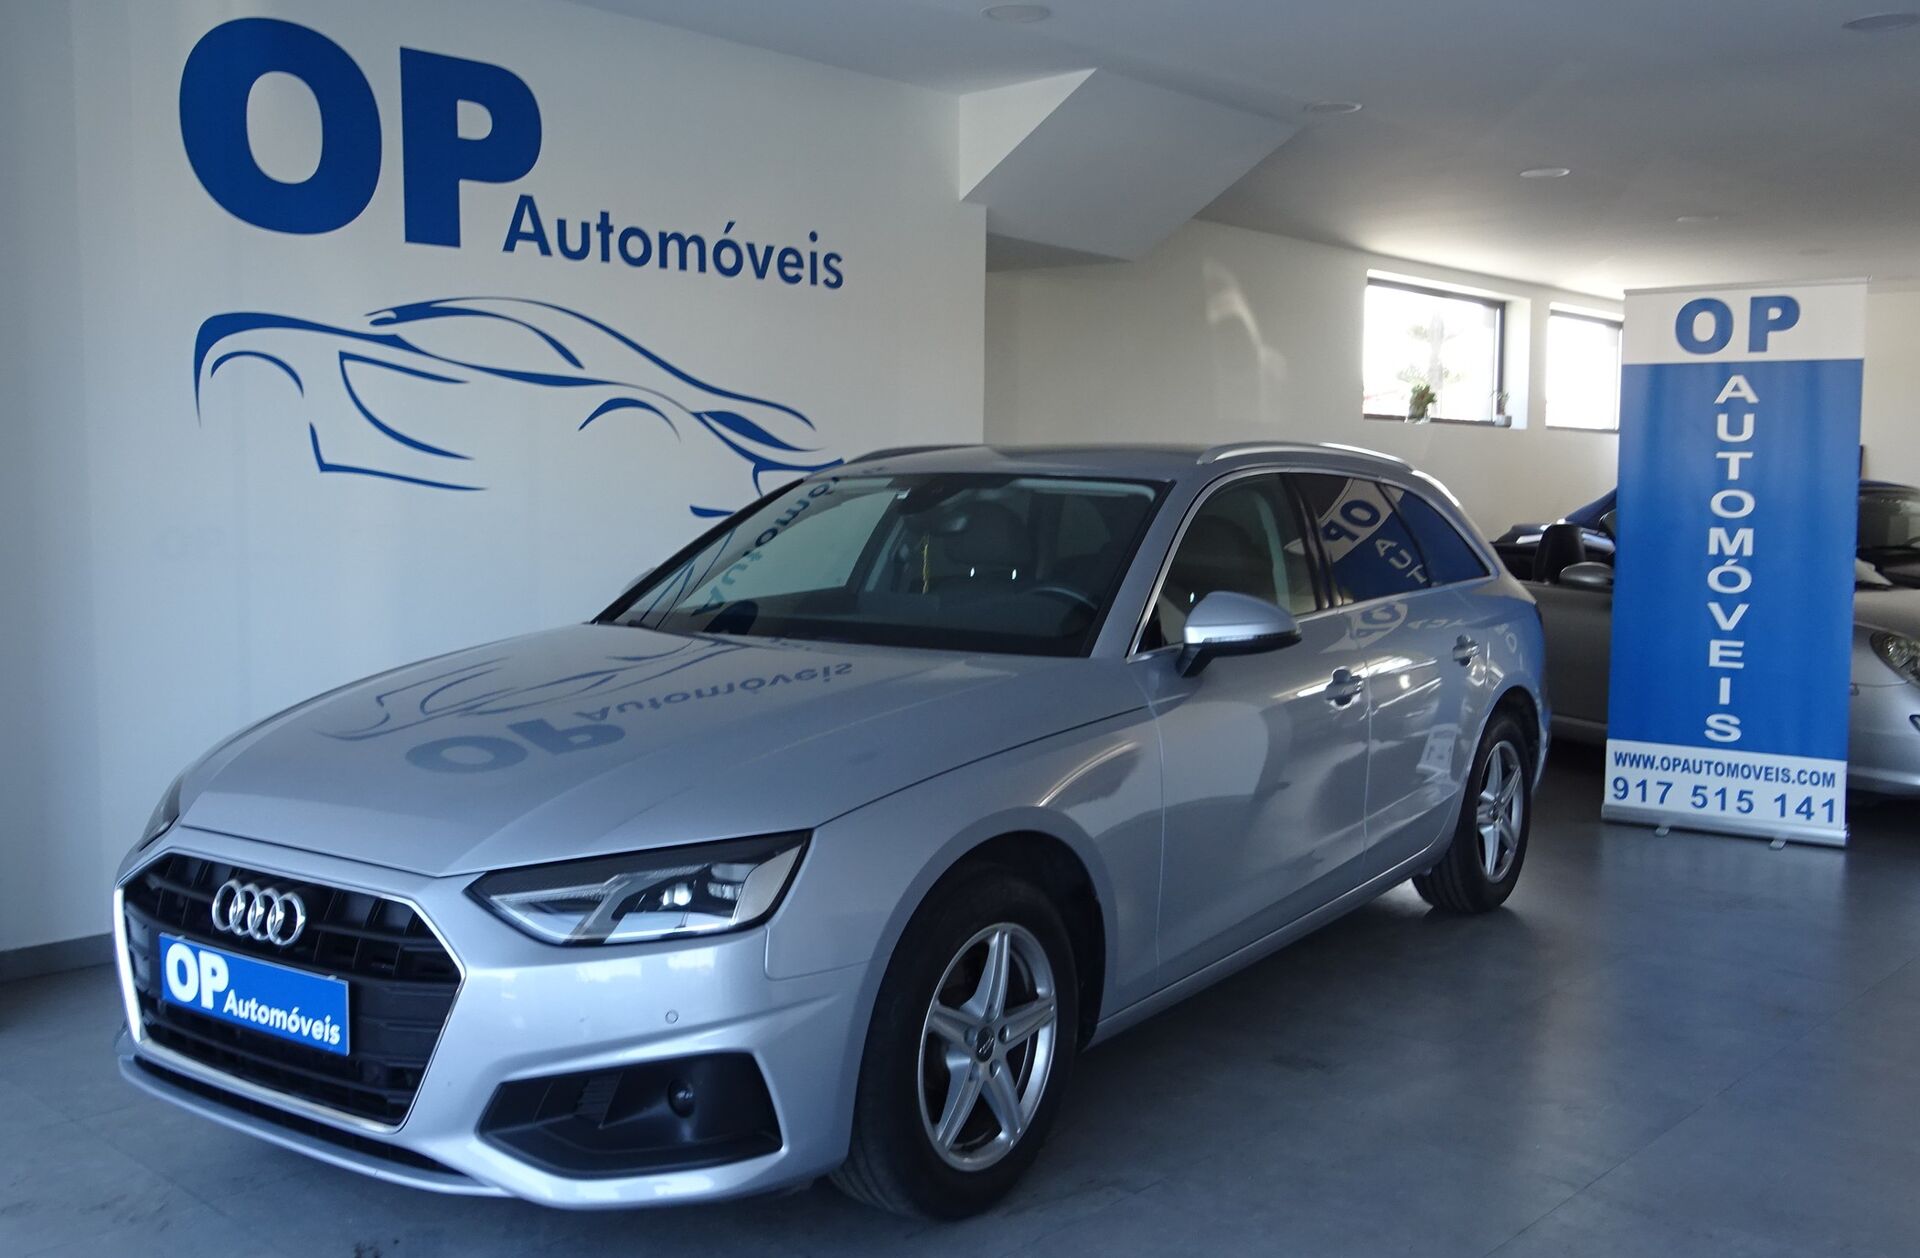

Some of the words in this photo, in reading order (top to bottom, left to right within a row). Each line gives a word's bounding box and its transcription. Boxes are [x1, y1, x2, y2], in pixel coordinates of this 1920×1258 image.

[179, 17, 542, 248] OP
[502, 194, 844, 290] Automóveis
[1675, 295, 1800, 355] OP
[1704, 374, 1760, 743] AUTOMÓVEIS
[1612, 776, 1673, 805] 917
[1690, 784, 1754, 814] 515
[1773, 793, 1835, 823] 141
[1613, 751, 1836, 788] WWW.OPAUTOMOVEIS.COM
[165, 942, 229, 1010] OP
[222, 989, 341, 1046] Automóveis
